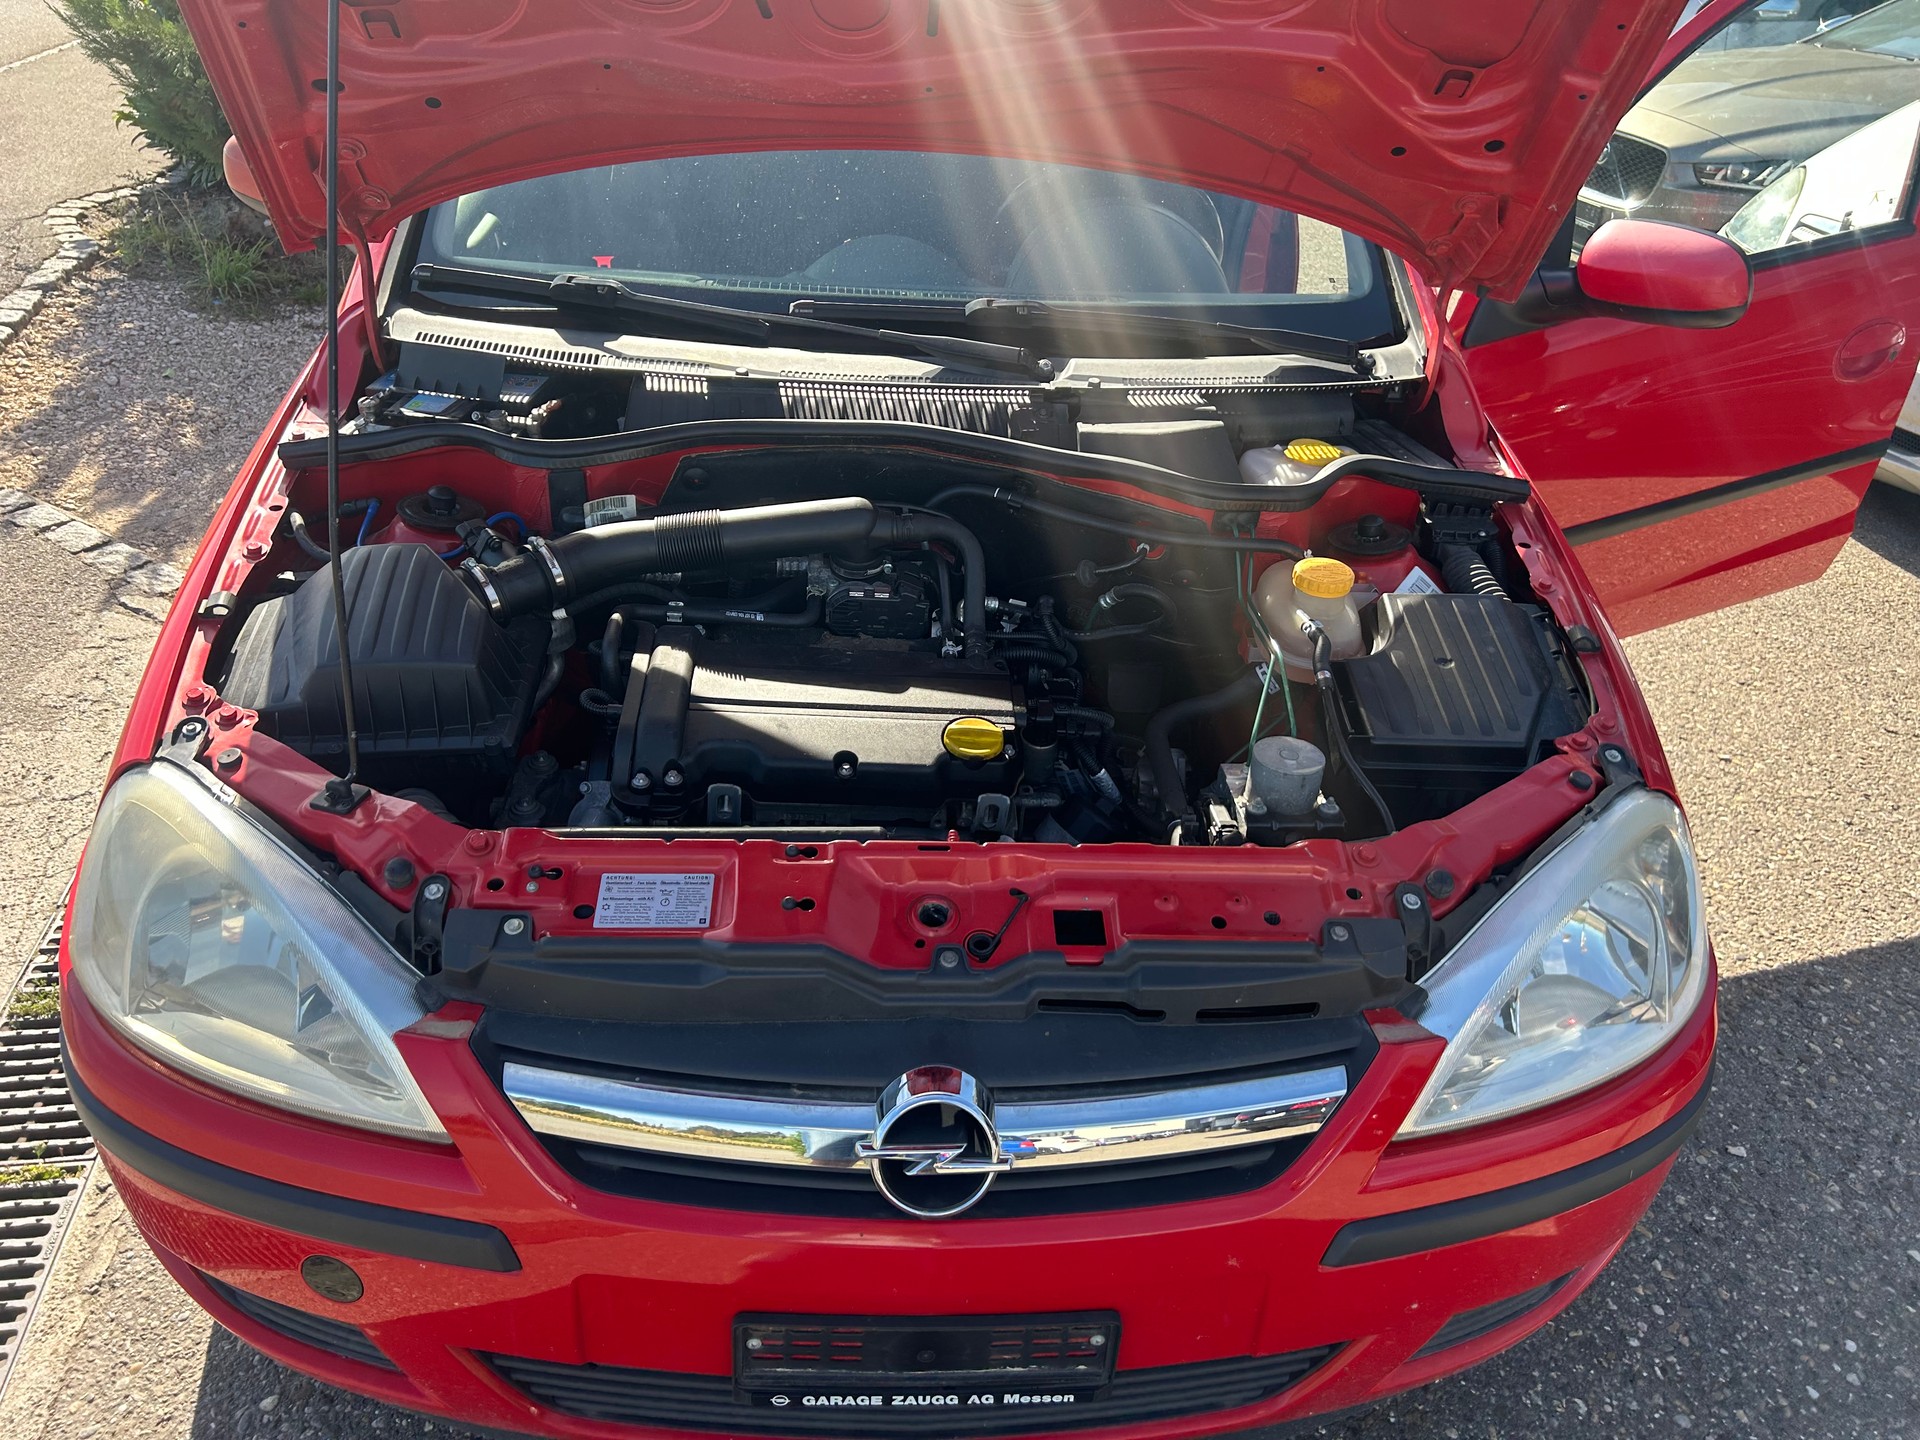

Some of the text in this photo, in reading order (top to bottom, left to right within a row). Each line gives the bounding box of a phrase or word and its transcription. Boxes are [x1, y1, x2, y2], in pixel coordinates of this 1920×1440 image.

[802, 1393, 1075, 1406] GARAGE ZAUGG AG Messen
